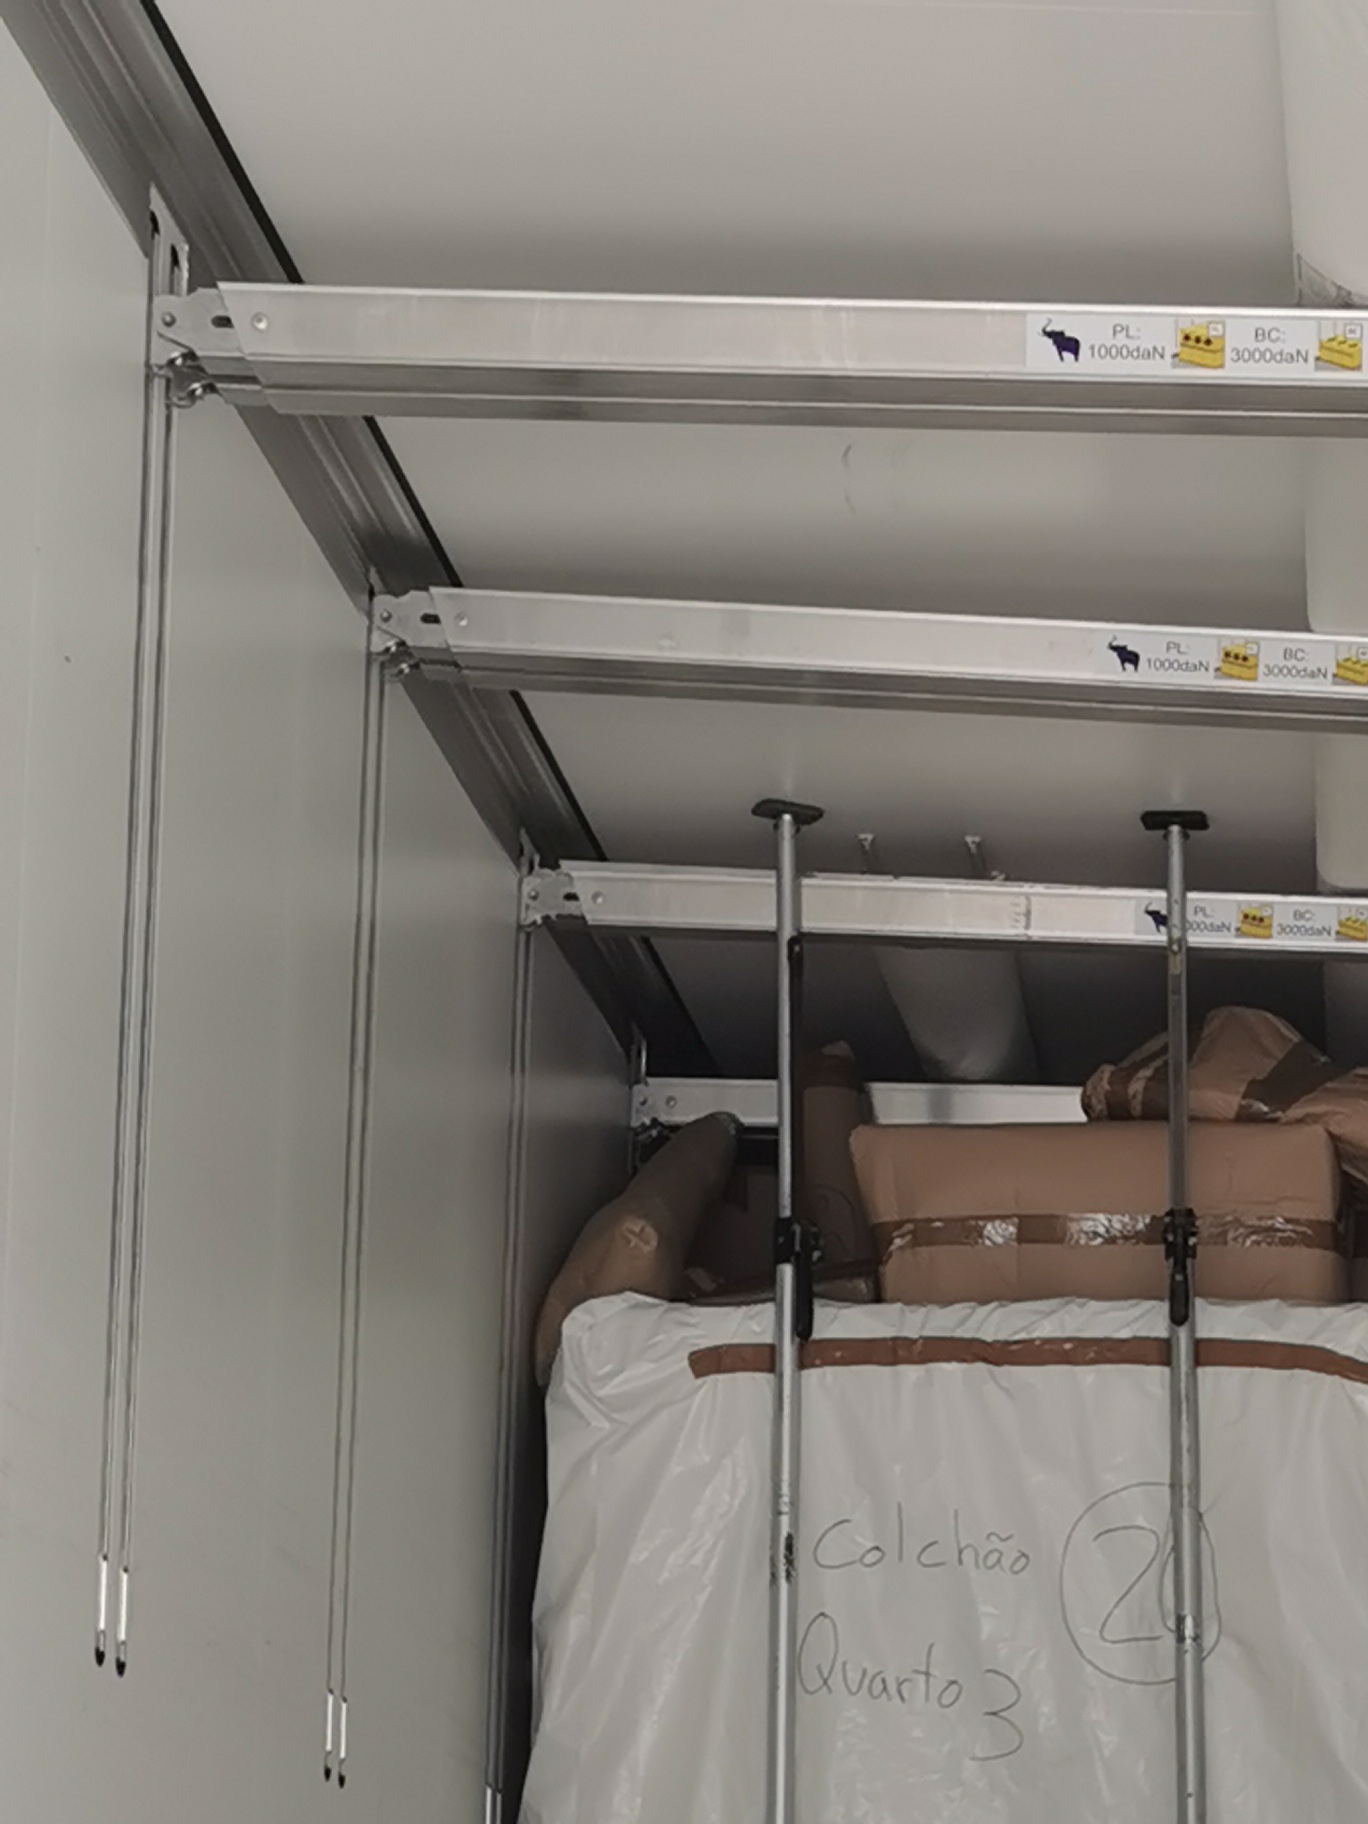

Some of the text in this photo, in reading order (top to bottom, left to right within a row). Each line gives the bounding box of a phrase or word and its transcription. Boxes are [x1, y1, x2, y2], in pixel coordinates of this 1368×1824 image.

[1111, 324, 1142, 340] PL:
[1254, 327, 1287, 344] BC:
[1087, 344, 1166, 362] 1000daN
[1229, 346, 1310, 365] 3000daN
[1145, 657, 1210, 674] 1000daN
[1262, 664, 1329, 681] 3000daN
[812, 1499, 1031, 1576] Colchão
[797, 1611, 1025, 1762] Quarto 3
